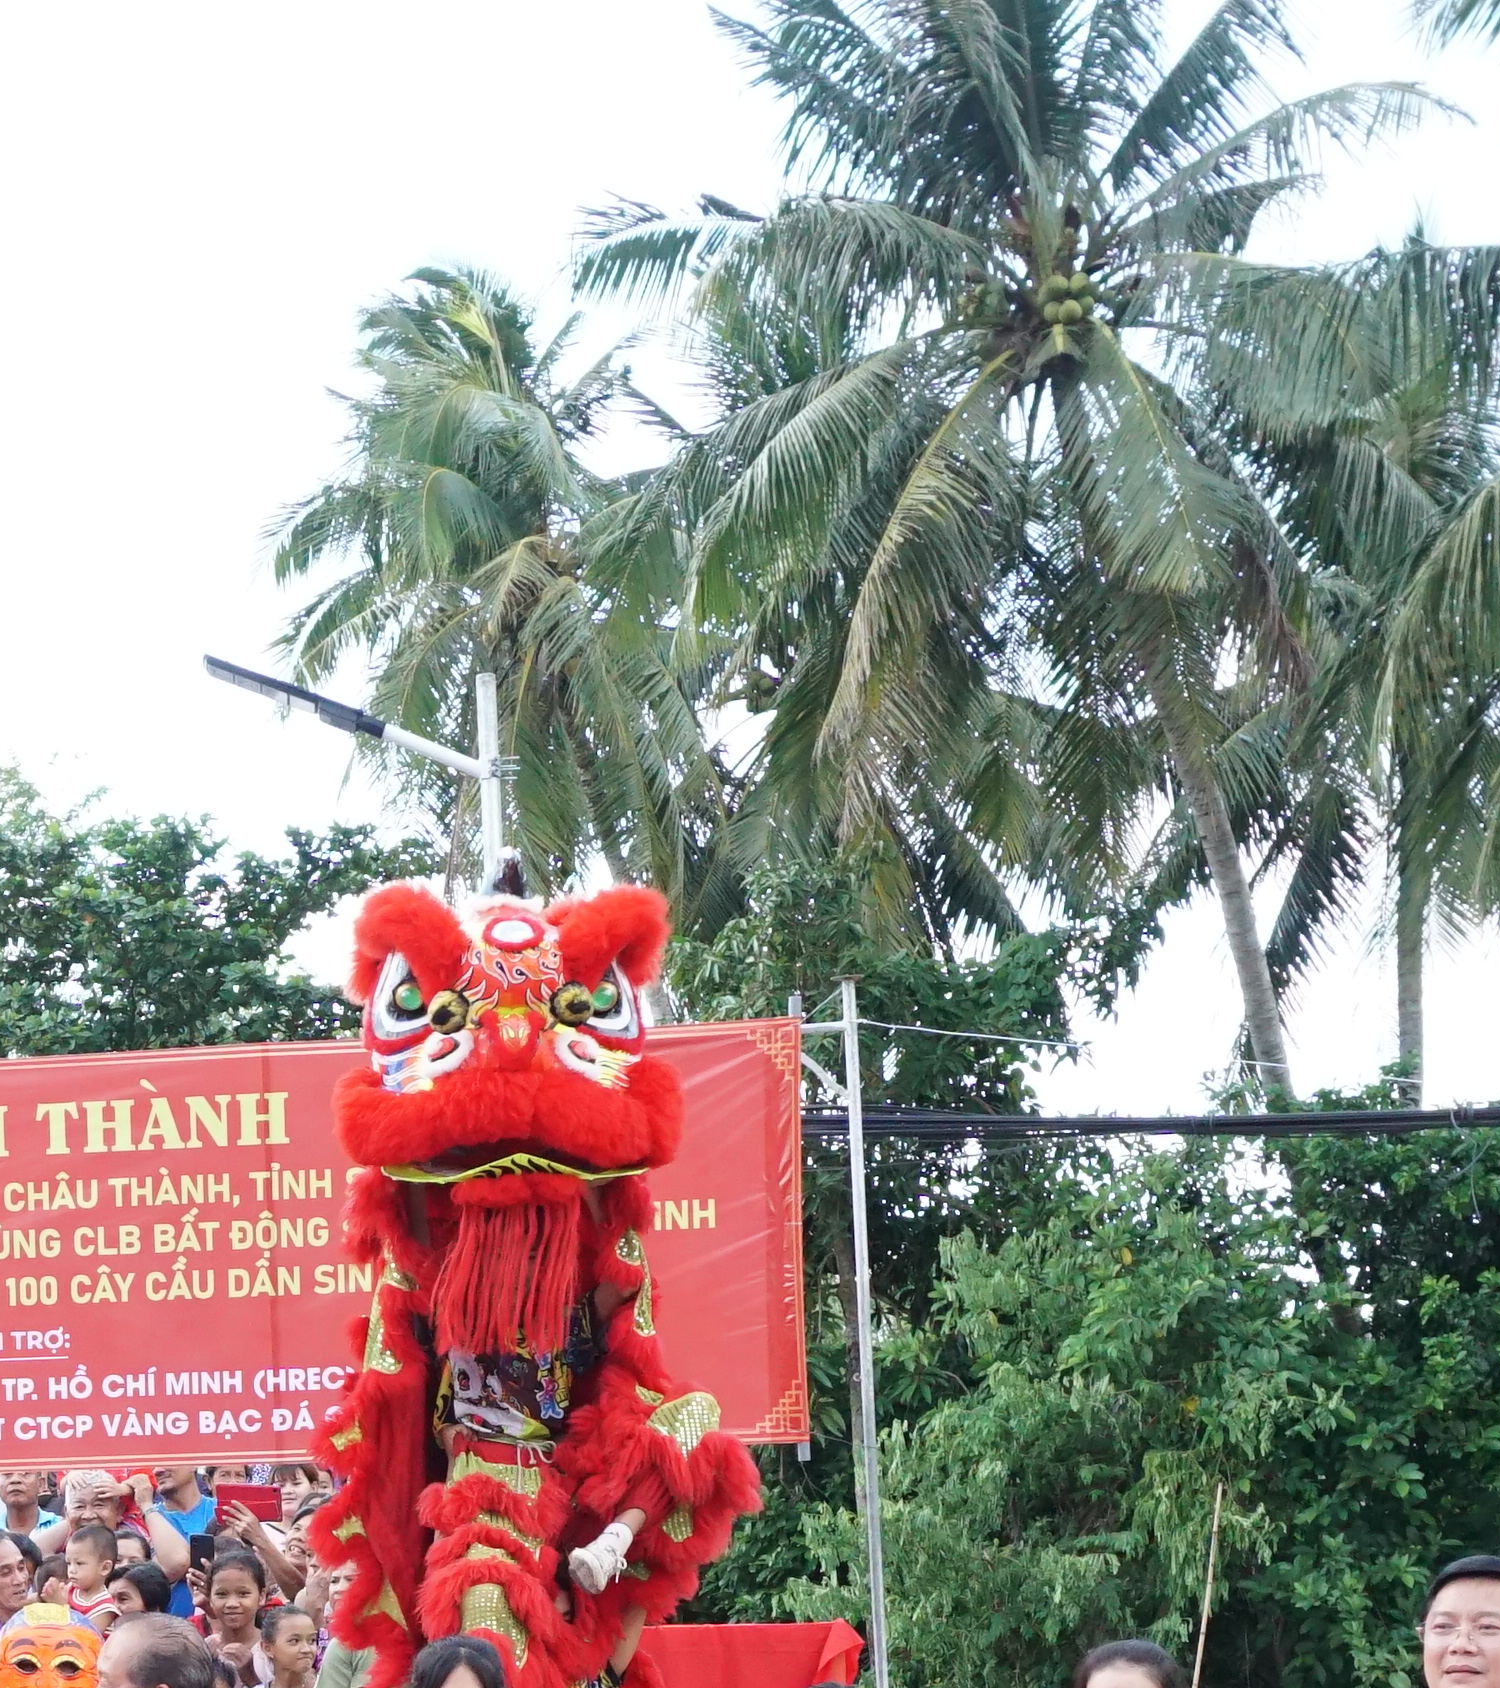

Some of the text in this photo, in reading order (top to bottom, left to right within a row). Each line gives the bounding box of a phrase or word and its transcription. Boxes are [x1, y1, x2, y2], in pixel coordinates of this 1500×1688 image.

[35, 1078, 290, 1156] THÀNH
[3, 1170, 99, 1212] CHÂU
[108, 1166, 241, 1208] THÀNH,
[248, 1162, 333, 1201] TỈNH
[73, 1225, 142, 1257] CLB
[153, 1206, 221, 1254] BẤT
[228, 1210, 330, 1259] ĐỘNG
[653, 1198, 716, 1231] INH
[5, 1275, 59, 1307] 100
[70, 1263, 136, 1304] CÂY
[145, 1255, 215, 1301] CẦU
[227, 1257, 301, 1298] DÂN
[313, 1262, 373, 1295] SIN
[10, 1325, 71, 1355] TRỢ:
[1, 1377, 38, 1402] TP.
[48, 1363, 93, 1400] HỒ
[101, 1366, 158, 1398] CHÍ
[165, 1370, 243, 1396] MINH
[13, 1414, 94, 1441] CTCP
[101, 1406, 190, 1437] VÀNG
[198, 1408, 263, 1440] BẠC
[270, 1400, 315, 1432] ĐÁ
